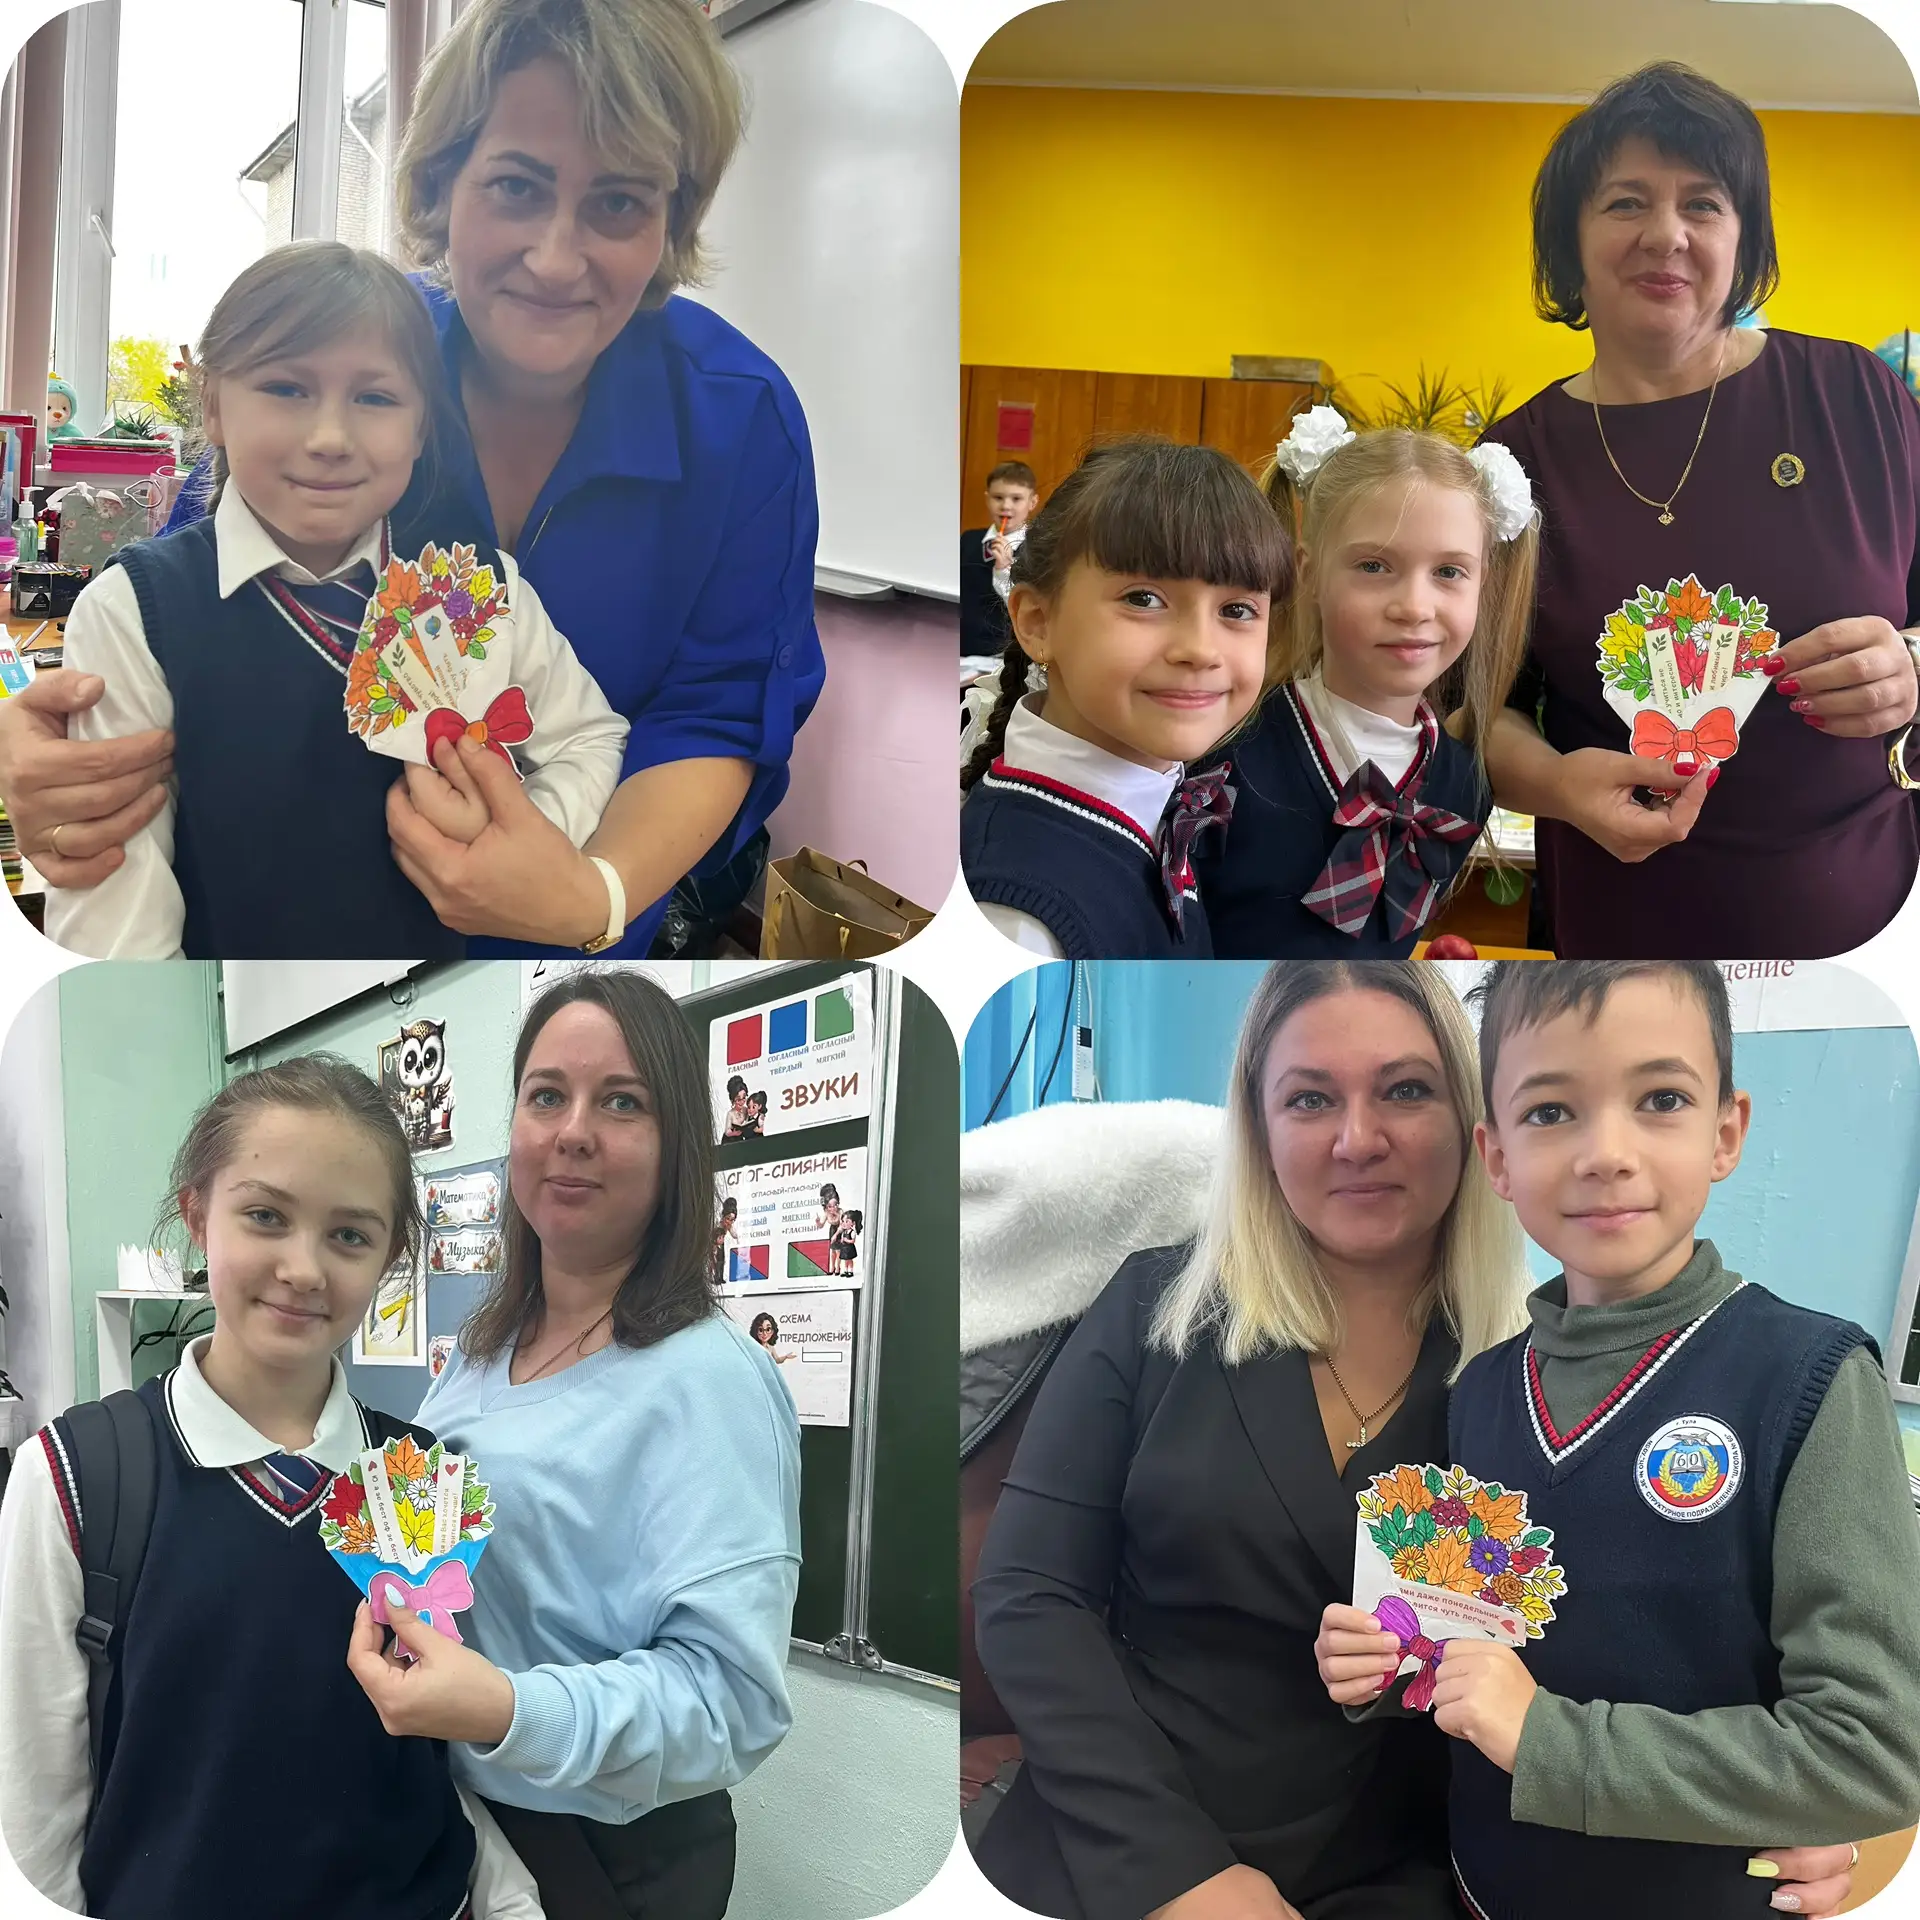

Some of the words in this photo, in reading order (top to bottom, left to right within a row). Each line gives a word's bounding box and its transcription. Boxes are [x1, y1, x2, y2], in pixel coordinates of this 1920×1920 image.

[1710, 651, 1720, 684] любимый
[1665, 660, 1680, 701] интересно!
[1661, 679, 1672, 708] учиться
[812, 1033, 856, 1051] СОГЛАСНЫЙ
[768, 1046, 809, 1063] СОГЛАСНЫЙ
[816, 1050, 846, 1064] МЯГКИЙ
[727, 1060, 759, 1073] ГЛАСНЫЙ
[780, 1072, 859, 1111] ЗВУКИ
[440, 1190, 486, 1204] Математика
[447, 1242, 485, 1261] Музыка
[779, 1313, 812, 1324] СХЕМА
[371, 1474, 379, 1483] Ю
[378, 1502, 388, 1520] бест
[383, 1521, 391, 1533] оф
[1646, 1491, 1686, 1518] СТРУКТУРНОЕ
[1686, 1480, 1736, 1518] ПОДРАЗДЕЛЕНИЕ
[1416, 1590, 1440, 1603] даже
[1442, 1597, 1500, 1620] понедельник
[1440, 1606, 1460, 1618] чуть
